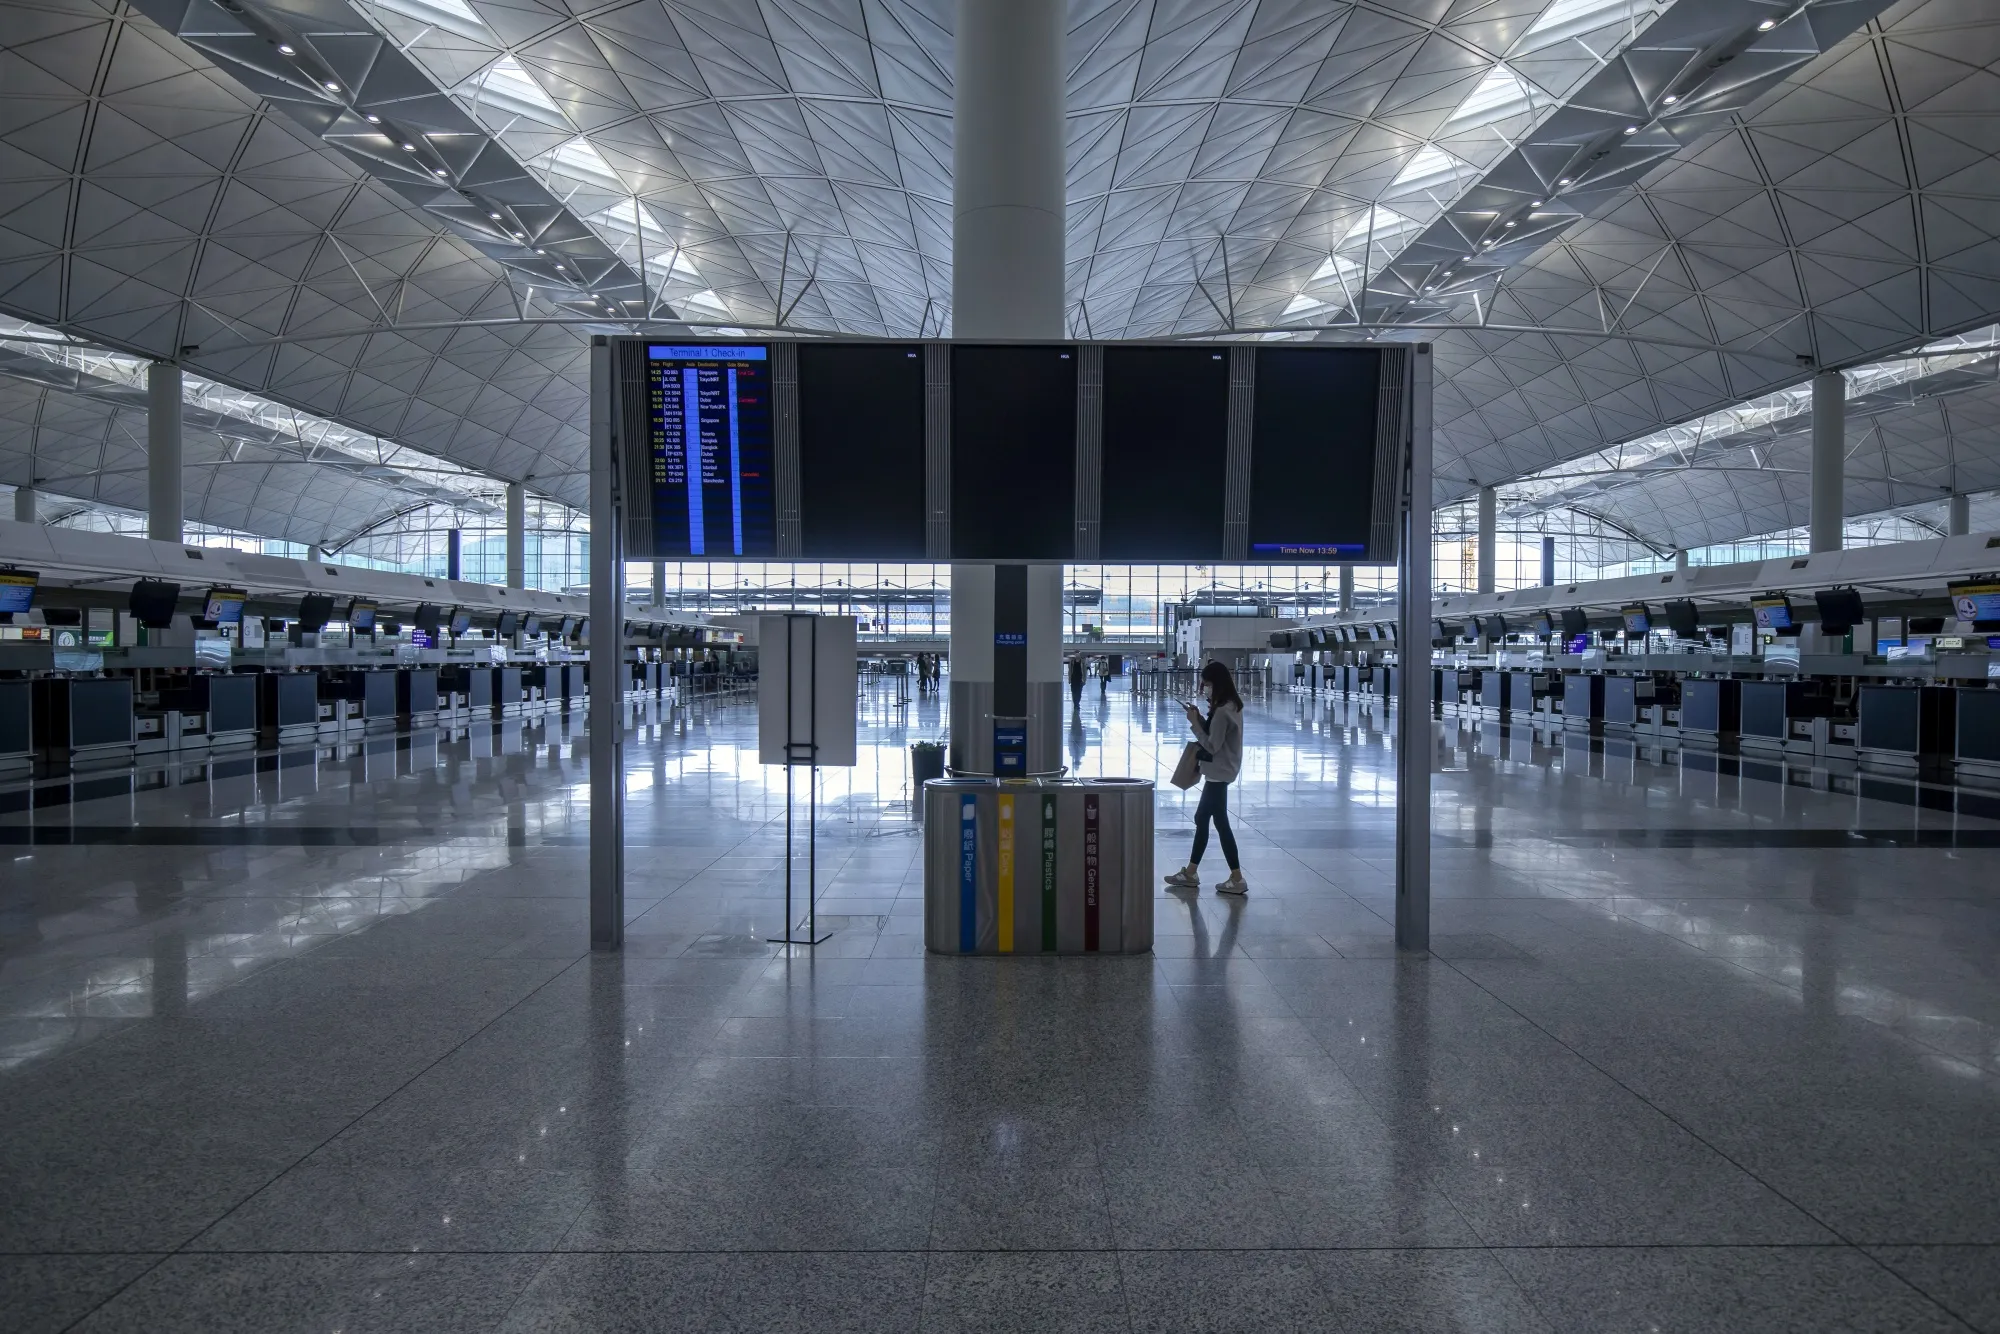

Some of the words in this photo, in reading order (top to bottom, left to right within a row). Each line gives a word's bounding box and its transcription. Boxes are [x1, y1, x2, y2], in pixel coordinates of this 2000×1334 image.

[669, 348, 702, 357] Terminal
[705, 348, 708, 357] 1
[712, 348, 746, 357] Check-in
[964, 853, 973, 882] Paper
[1045, 852, 1053, 890] Plastics
[1088, 869, 1096, 906] General
